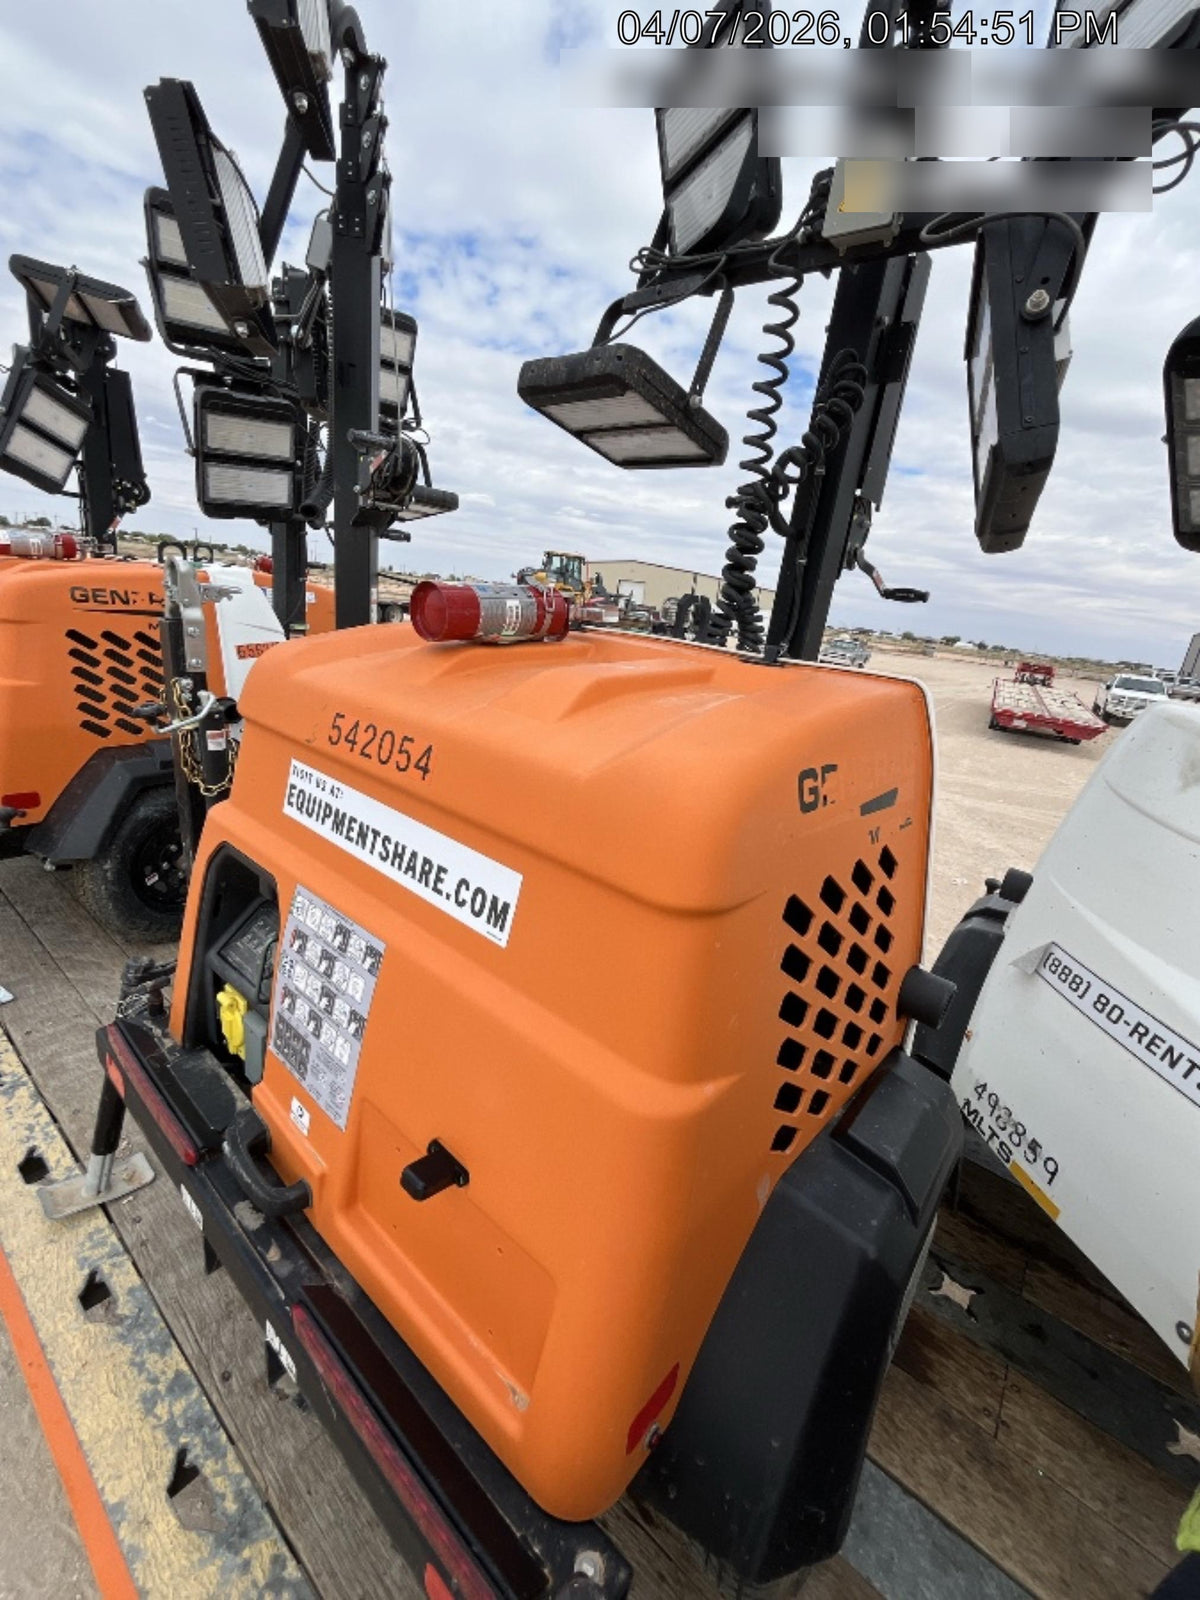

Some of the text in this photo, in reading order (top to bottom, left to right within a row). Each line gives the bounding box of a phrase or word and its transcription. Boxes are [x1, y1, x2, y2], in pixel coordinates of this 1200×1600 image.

[328, 712, 433, 781] 542054
[287, 783, 511, 933] EQUIPMENTSHARE.COM
[1043, 952, 1200, 1091] (888) 80-RENT
[960, 1098, 1013, 1164] MLTS
